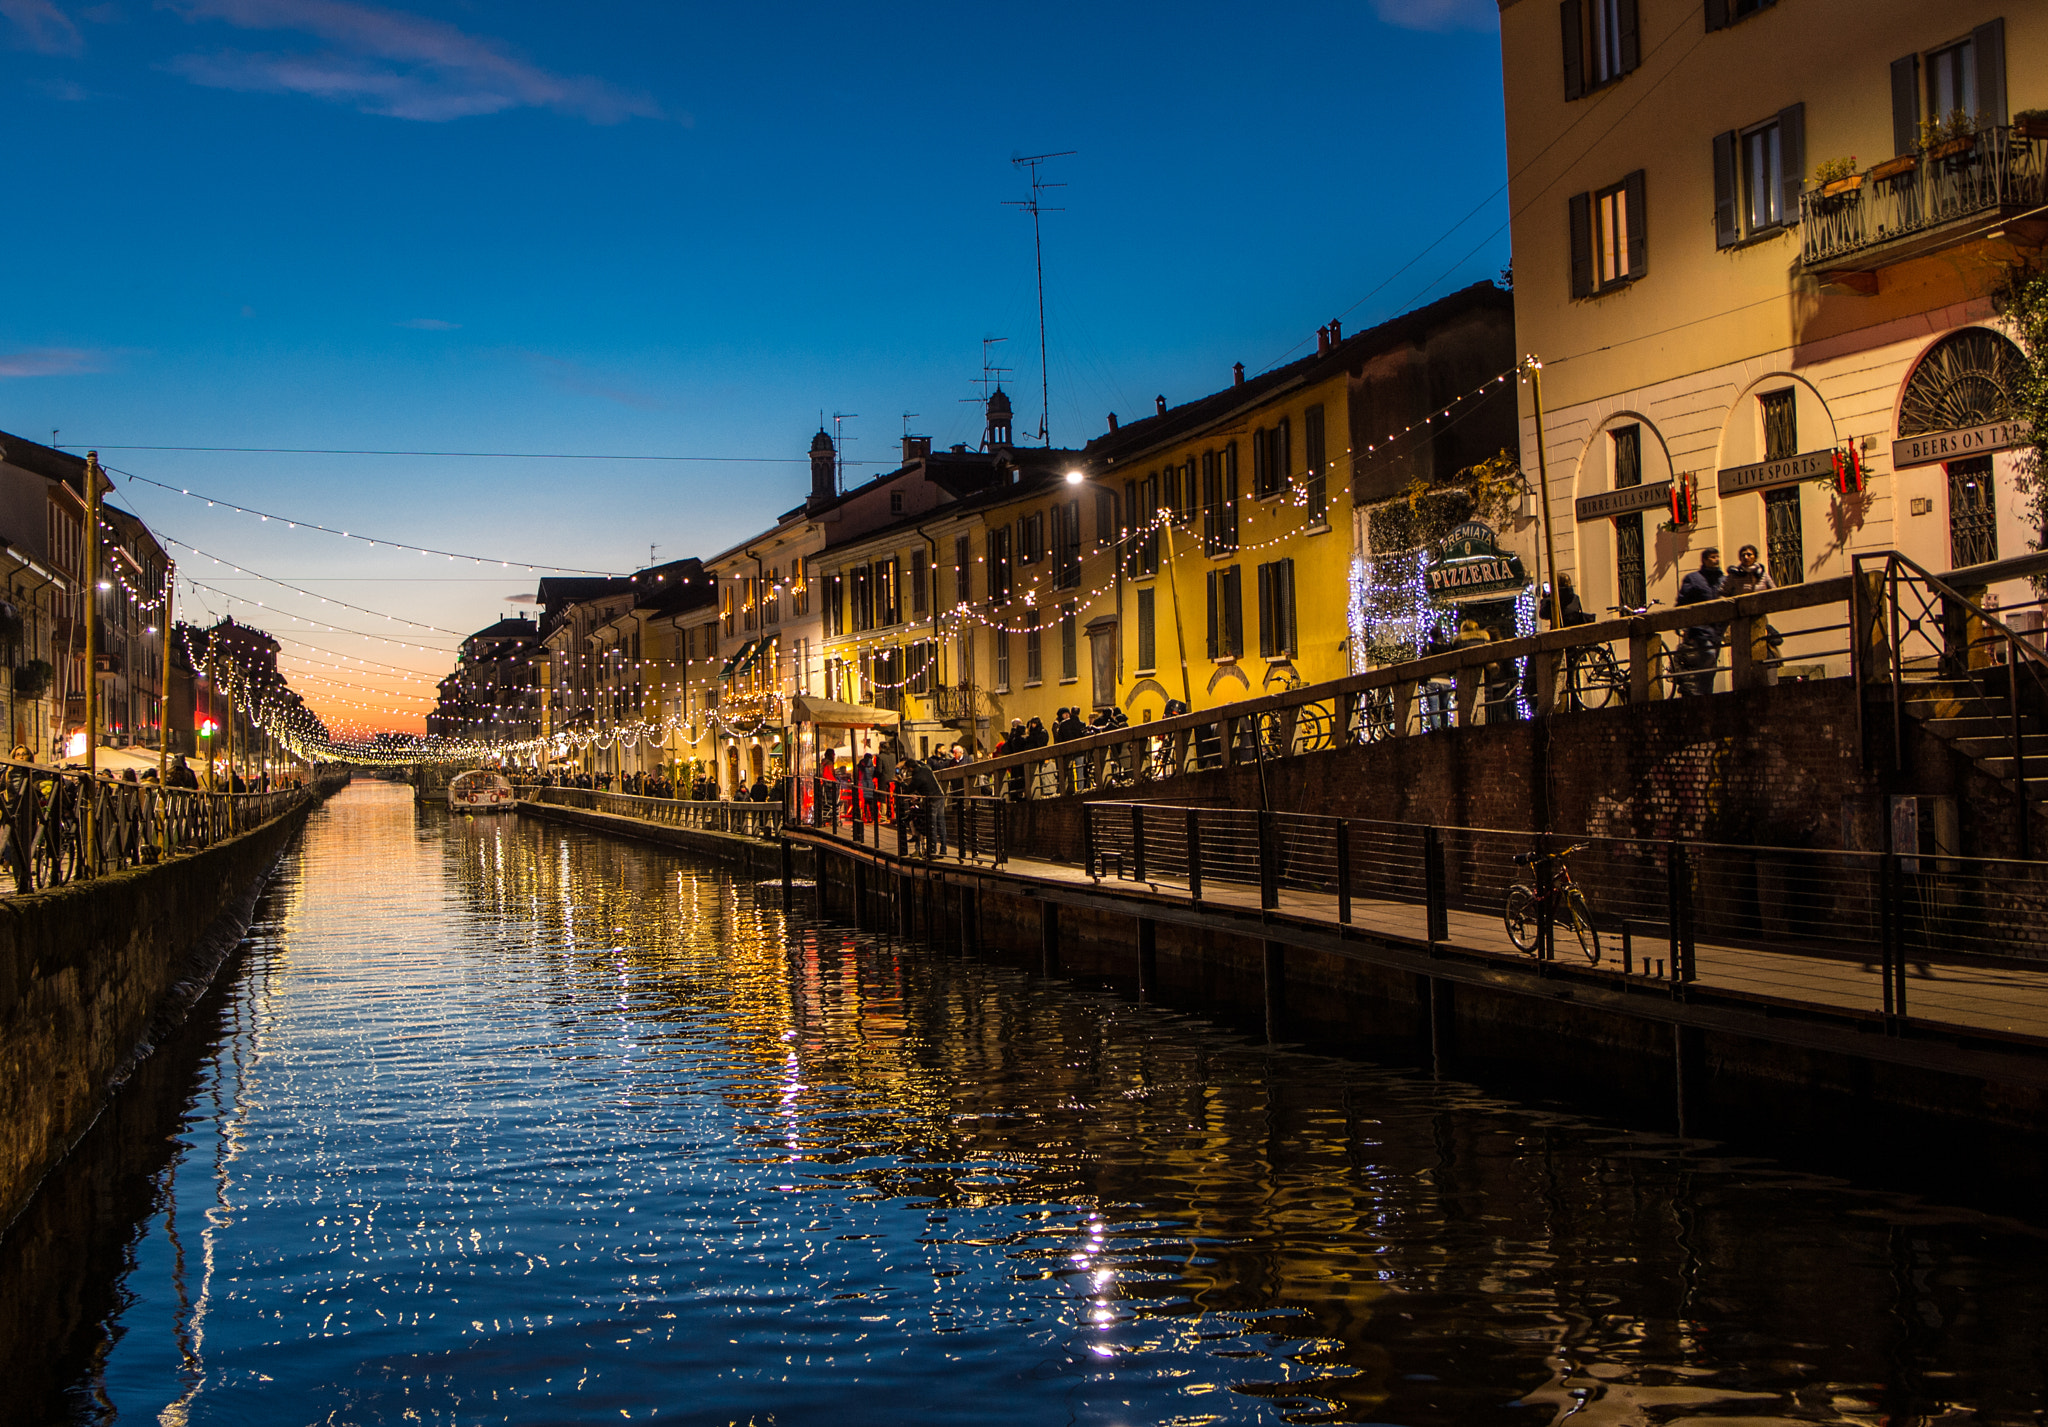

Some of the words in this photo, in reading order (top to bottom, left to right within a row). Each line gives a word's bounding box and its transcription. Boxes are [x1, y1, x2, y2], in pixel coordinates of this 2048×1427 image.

[1912, 435, 1957, 458] BEERS
[1963, 431, 1984, 448] ON
[1990, 423, 2021, 443] TAP
[1738, 468, 1765, 486] LIVE
[1768, 458, 1816, 480] SPORTS
[1582, 498, 1610, 514] BIRRE
[1613, 494, 1636, 510] ALLA
[1638, 487, 1668, 503] SPINA
[1441, 526, 1492, 552] PREMIATA
[1431, 560, 1515, 589] PIZZERIA
